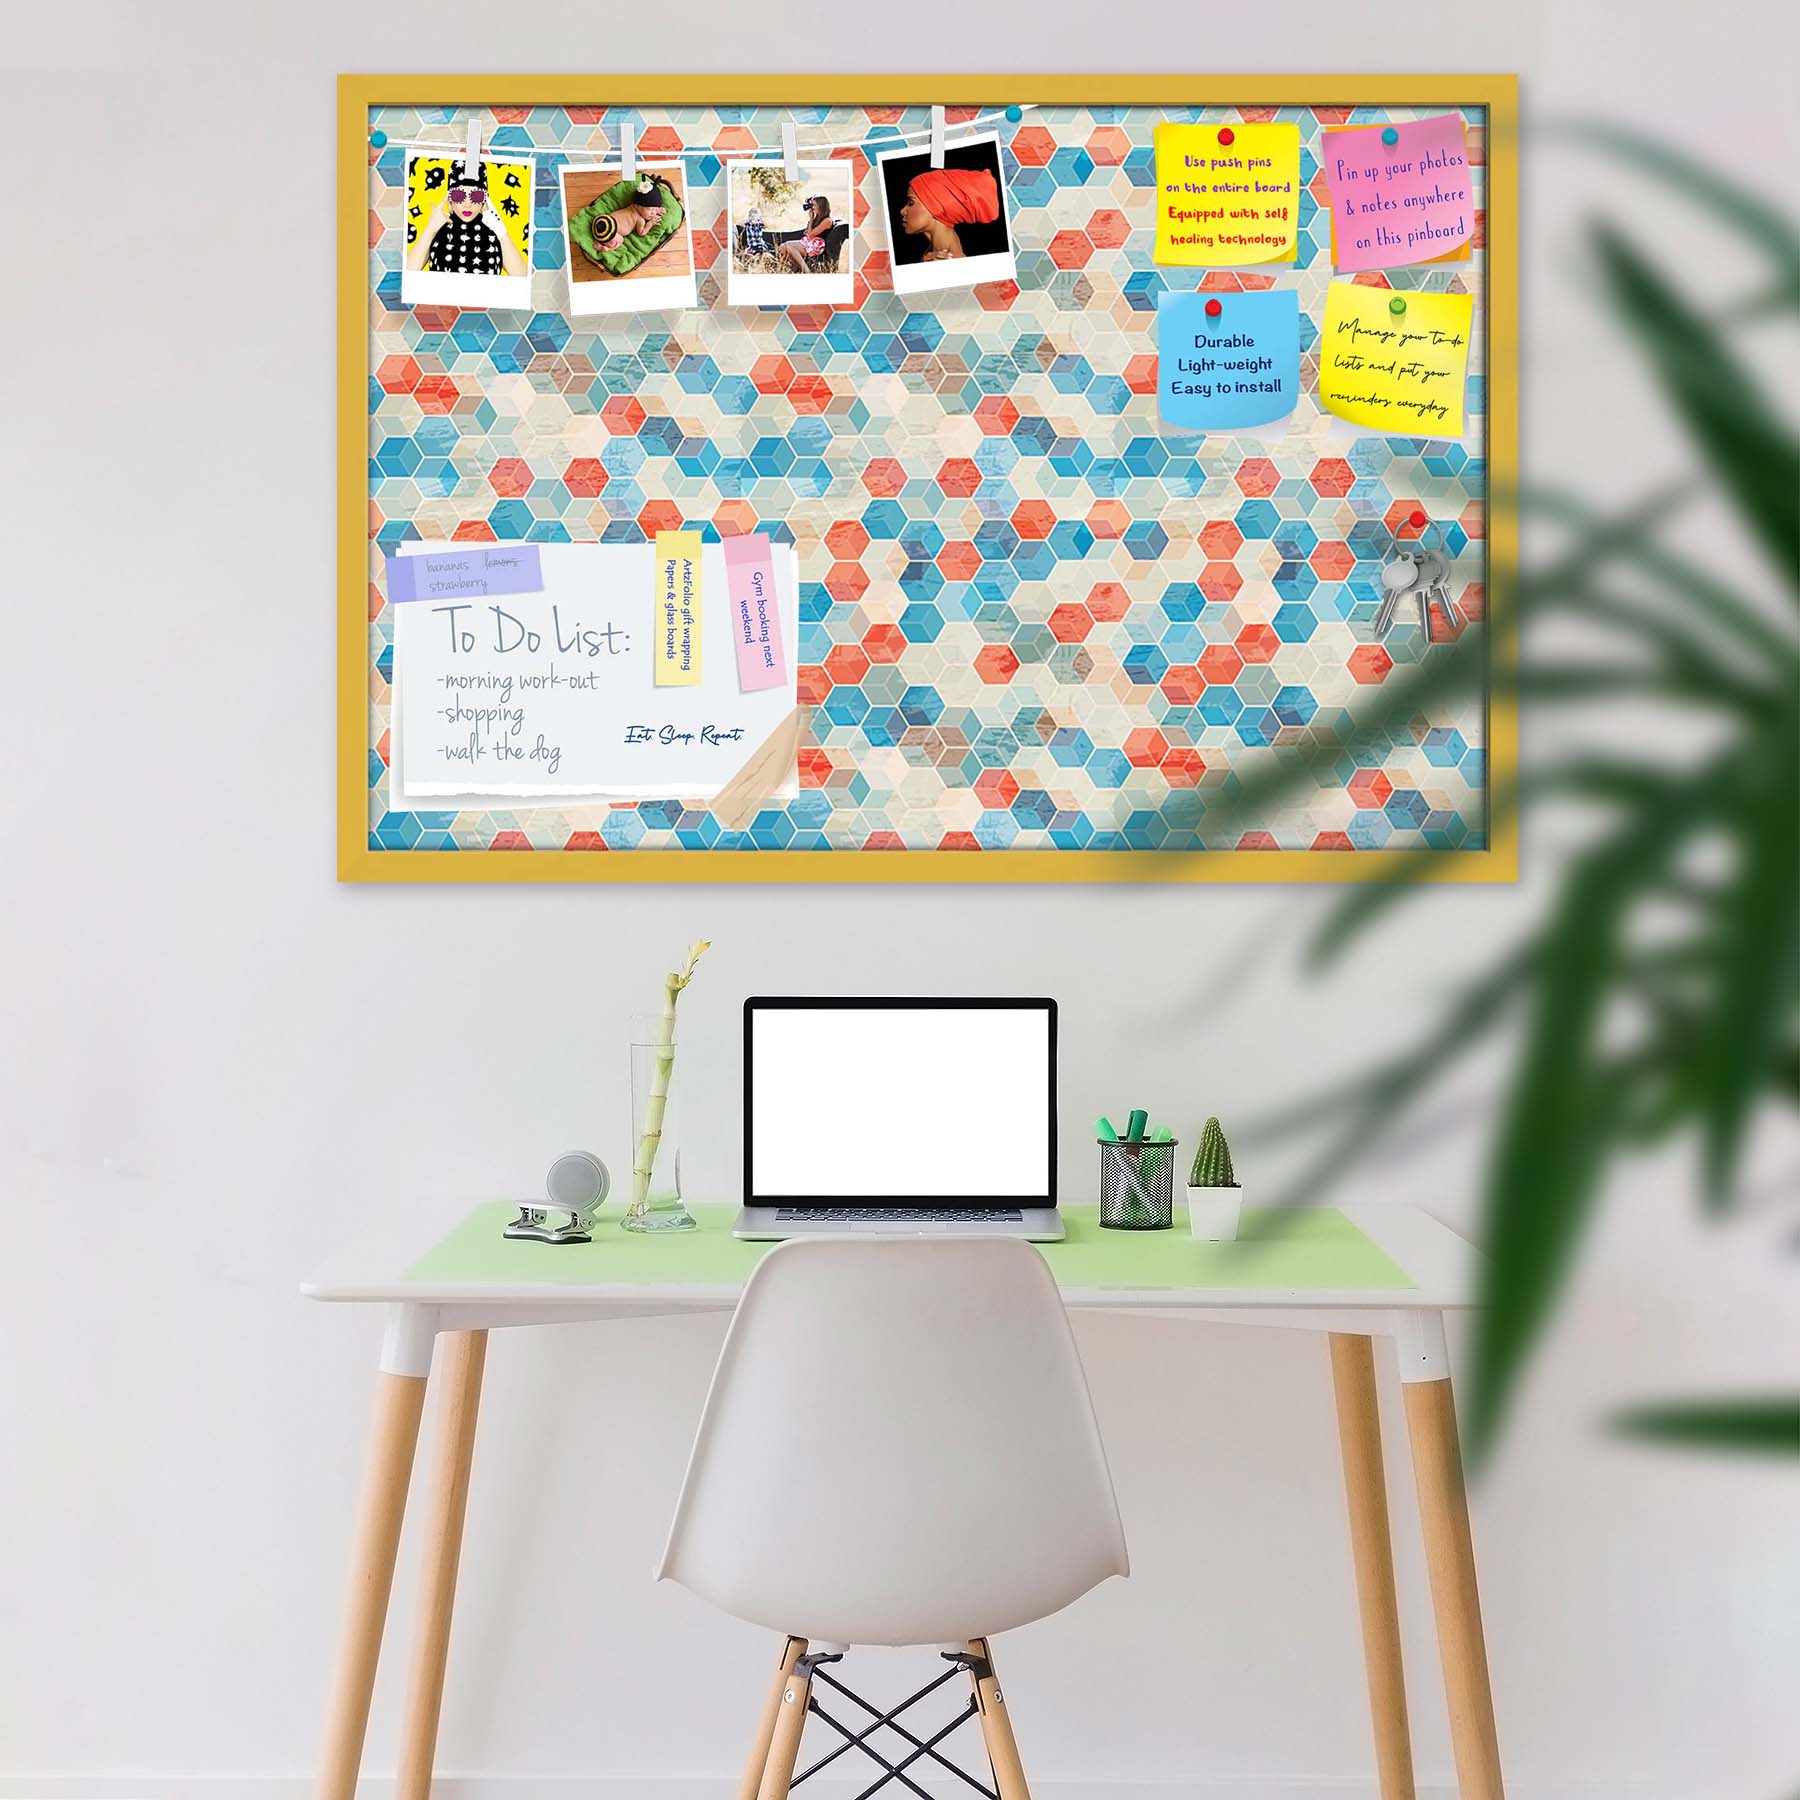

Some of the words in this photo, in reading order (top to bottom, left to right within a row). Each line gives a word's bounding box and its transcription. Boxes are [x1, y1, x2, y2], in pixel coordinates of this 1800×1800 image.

[1185, 155, 1206, 168] Use
[1211, 156, 1243, 170] push
[1248, 156, 1272, 170] pins
[1337, 160, 1358, 182] Pin
[1365, 167, 1378, 183] up
[1385, 164, 1412, 180] your
[1419, 149, 1463, 169] photos
[1166, 183, 1180, 193] on
[1185, 182, 1207, 193] the
[1213, 182, 1249, 193] entire
[1255, 181, 1290, 193] board
[1169, 207, 1224, 222] Equipped
[1230, 208, 1259, 219] with
[1265, 207, 1288, 220] self
[1346, 199, 1355, 216] &
[1362, 195, 1397, 215] notes
[1404, 188, 1465, 210] anywhere
[1171, 234, 1214, 247] healing
[1218, 233, 1287, 247] technology
[1356, 235, 1371, 249] on
[1376, 227, 1401, 246] this
[1407, 217, 1465, 247] pinboard
[1194, 334, 1254, 348] Durable
[1338, 318, 1396, 344] Manage
[1399, 331, 1427, 346] your
[1178, 357, 1273, 375] Light-weight
[1334, 354, 1364, 371] lists
[1369, 359, 1395, 372] and
[1398, 362, 1423, 378] put
[1424, 368, 1451, 383] your
[1172, 381, 1211, 396] Easy
[1216, 382, 1231, 394] to
[1235, 379, 1281, 393] install
[1331, 392, 1392, 408] reminders
[1397, 401, 1449, 421] everyday
[426, 560, 469, 573] bananas
[665, 560, 676, 593] Papers
[429, 577, 488, 593] strawberry
[683, 559, 692, 606] ArtzFolio
[753, 572, 763, 597] Gym
[664, 604, 677, 625] glass
[680, 608, 695, 625] gift
[740, 600, 756, 644] weekend
[757, 599, 769, 642] booking
[432, 605, 475, 653] To
[489, 606, 541, 653] Do
[553, 605, 630, 657] List:
[666, 627, 675, 660] boards
[680, 627, 690, 671] wrapping
[764, 645, 775, 668] next
[520, 662, 600, 690] work-out
[493, 731, 525, 761] the
[530, 734, 562, 774] dog
